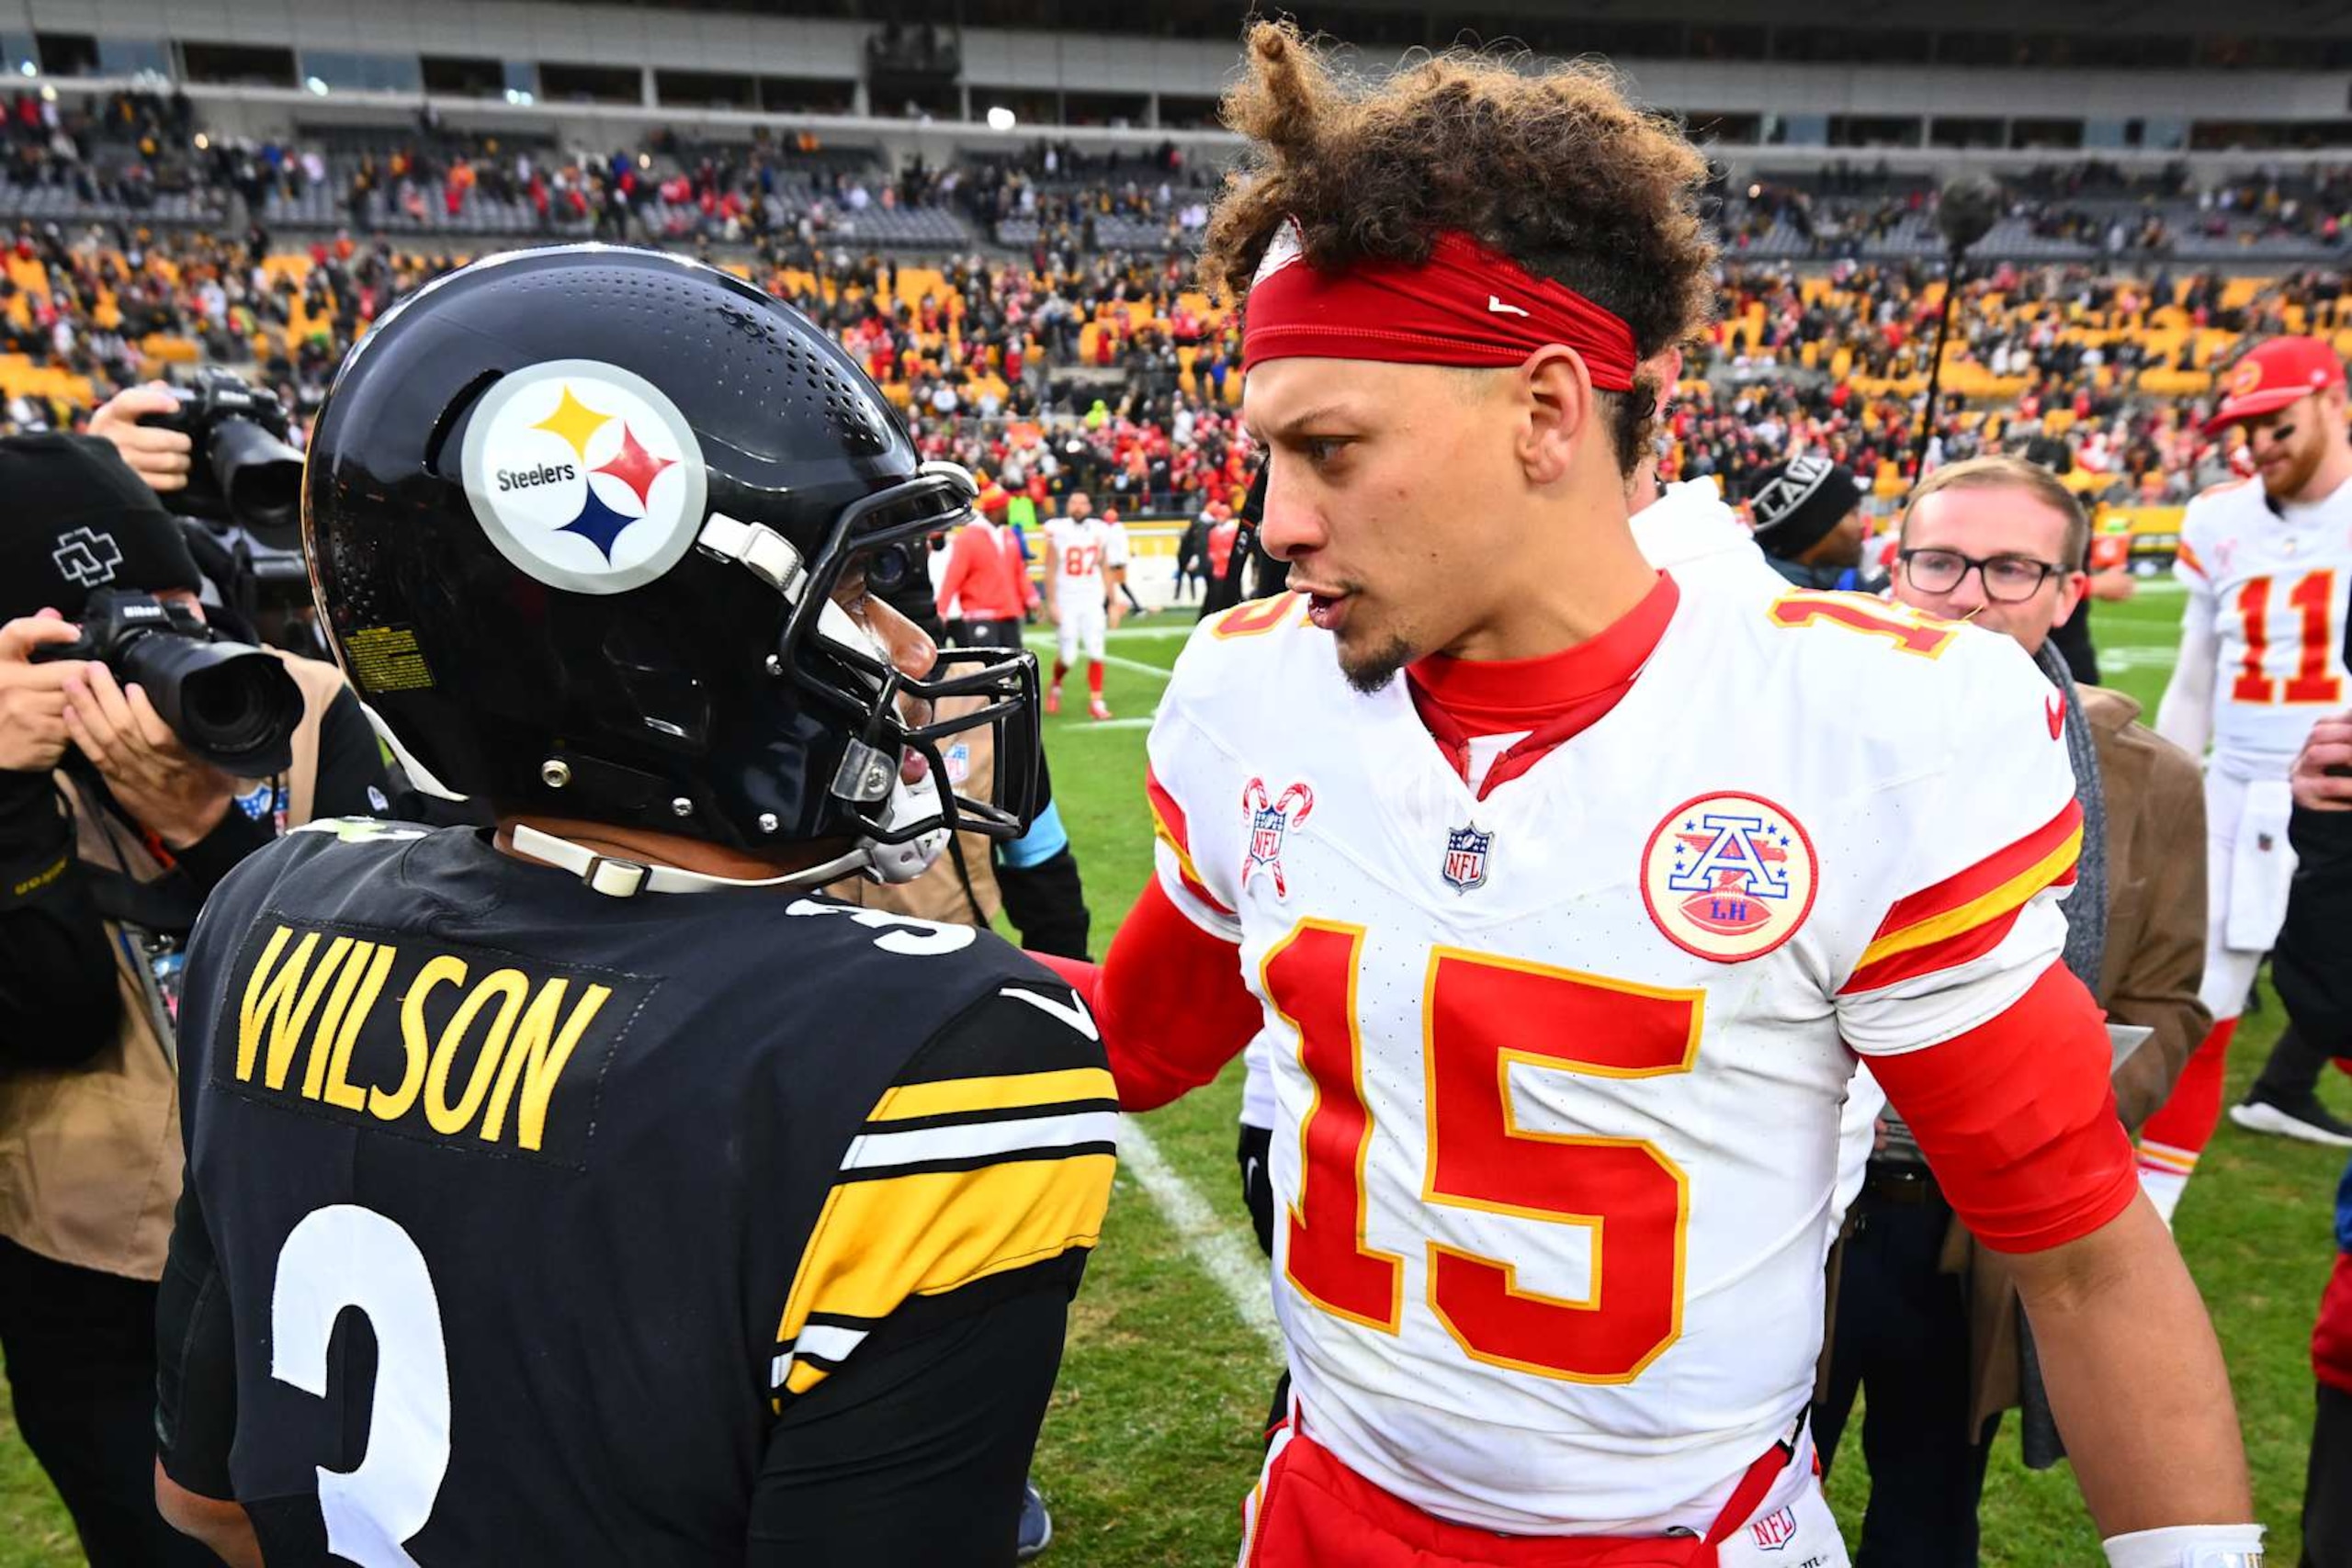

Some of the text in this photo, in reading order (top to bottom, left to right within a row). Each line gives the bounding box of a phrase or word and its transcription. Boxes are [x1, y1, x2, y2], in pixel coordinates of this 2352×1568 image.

[497, 463, 575, 491] Steelers
[1066, 546, 1100, 576] 87
[2231, 569, 2343, 705] 11
[1251, 829, 1279, 859] NFL
[1446, 852, 1479, 881] NFL
[1709, 899, 1747, 921] LH
[235, 925, 613, 1152] WILSON
[1260, 916, 1707, 1384] 15
[271, 1203, 452, 1568] 3
[1751, 1508, 1793, 1546] NFL
